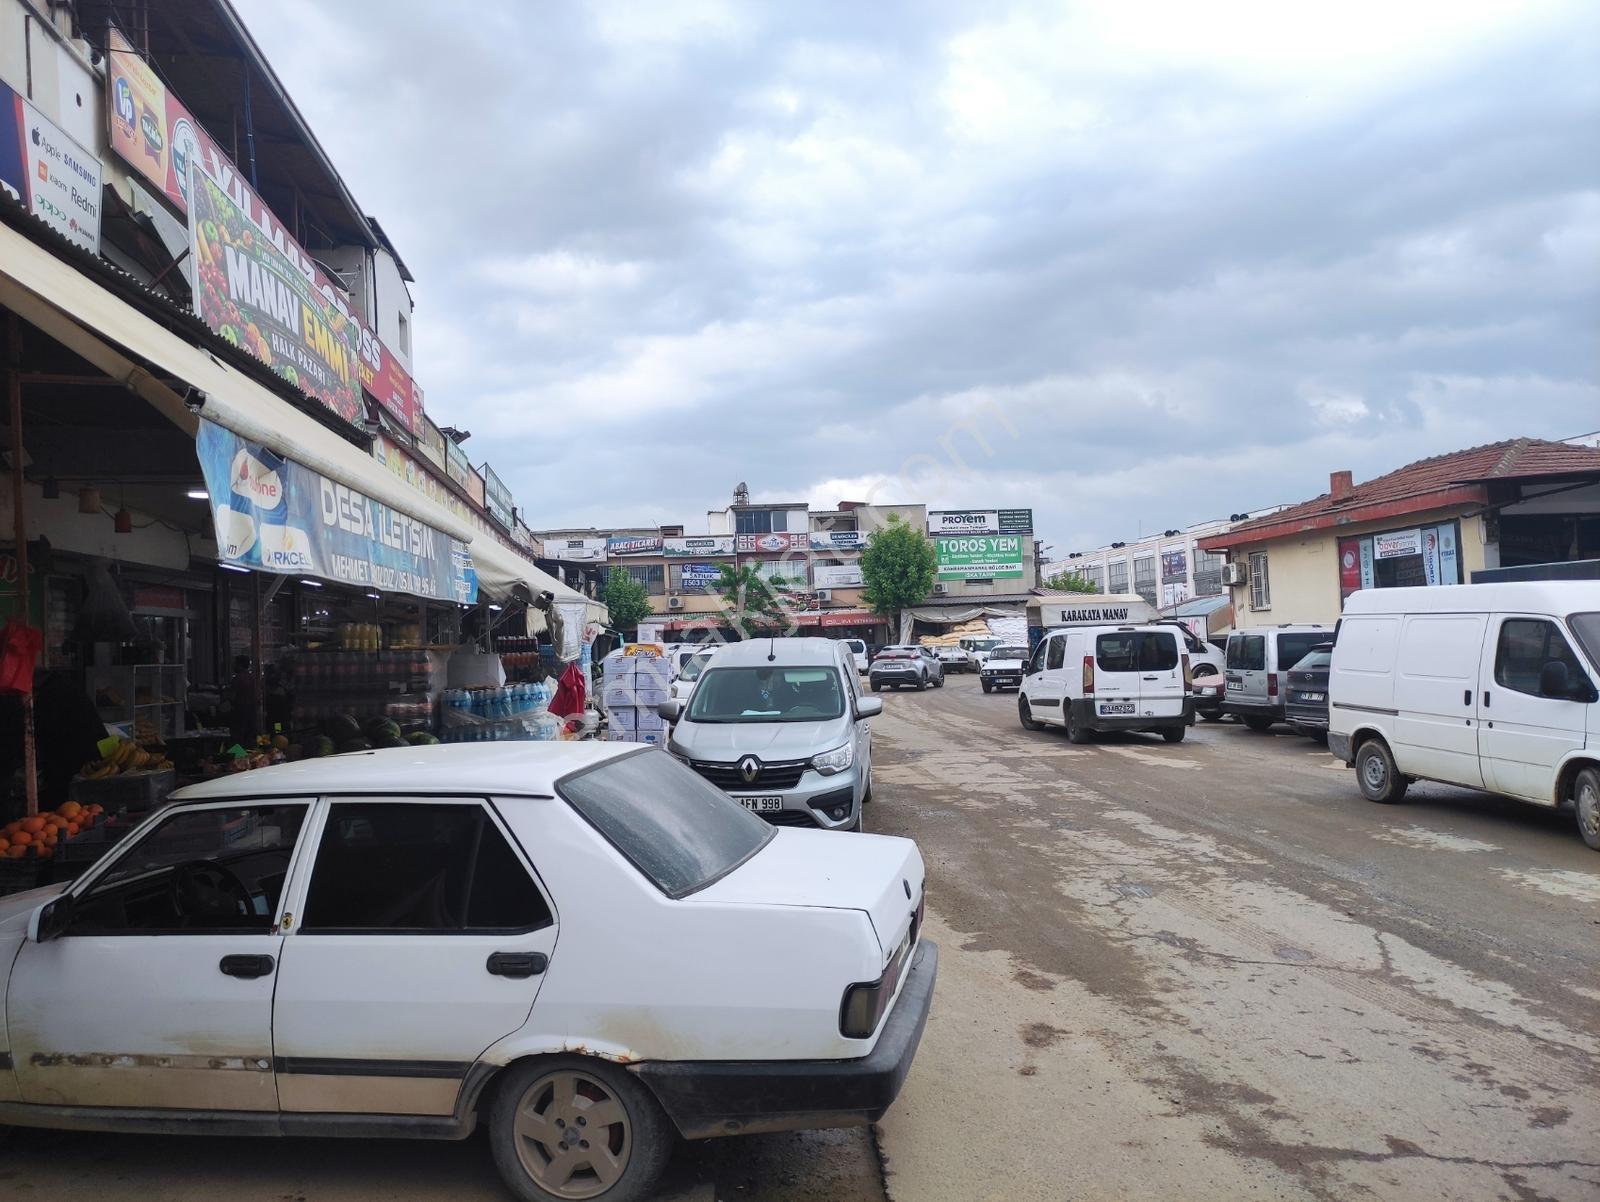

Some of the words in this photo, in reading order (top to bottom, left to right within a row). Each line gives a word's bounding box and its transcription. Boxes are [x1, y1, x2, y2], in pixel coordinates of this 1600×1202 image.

[41, 136, 61, 161] Apple
[64, 153, 96, 187] SAMSUNG
[71, 185, 97, 218] Redmi
[224, 245, 299, 337] MANAV
[272, 333, 296, 362] HALK
[298, 348, 326, 386] PAZARI
[320, 475, 376, 542] DESA
[940, 539, 987, 553] TOROS
[990, 538, 1018, 552] YEM
[332, 554, 369, 582] MEHMET
[1061, 608, 1101, 622] KARAKAYA
[1103, 608, 1128, 621] MANAV
[761, 798, 780, 810] 998
